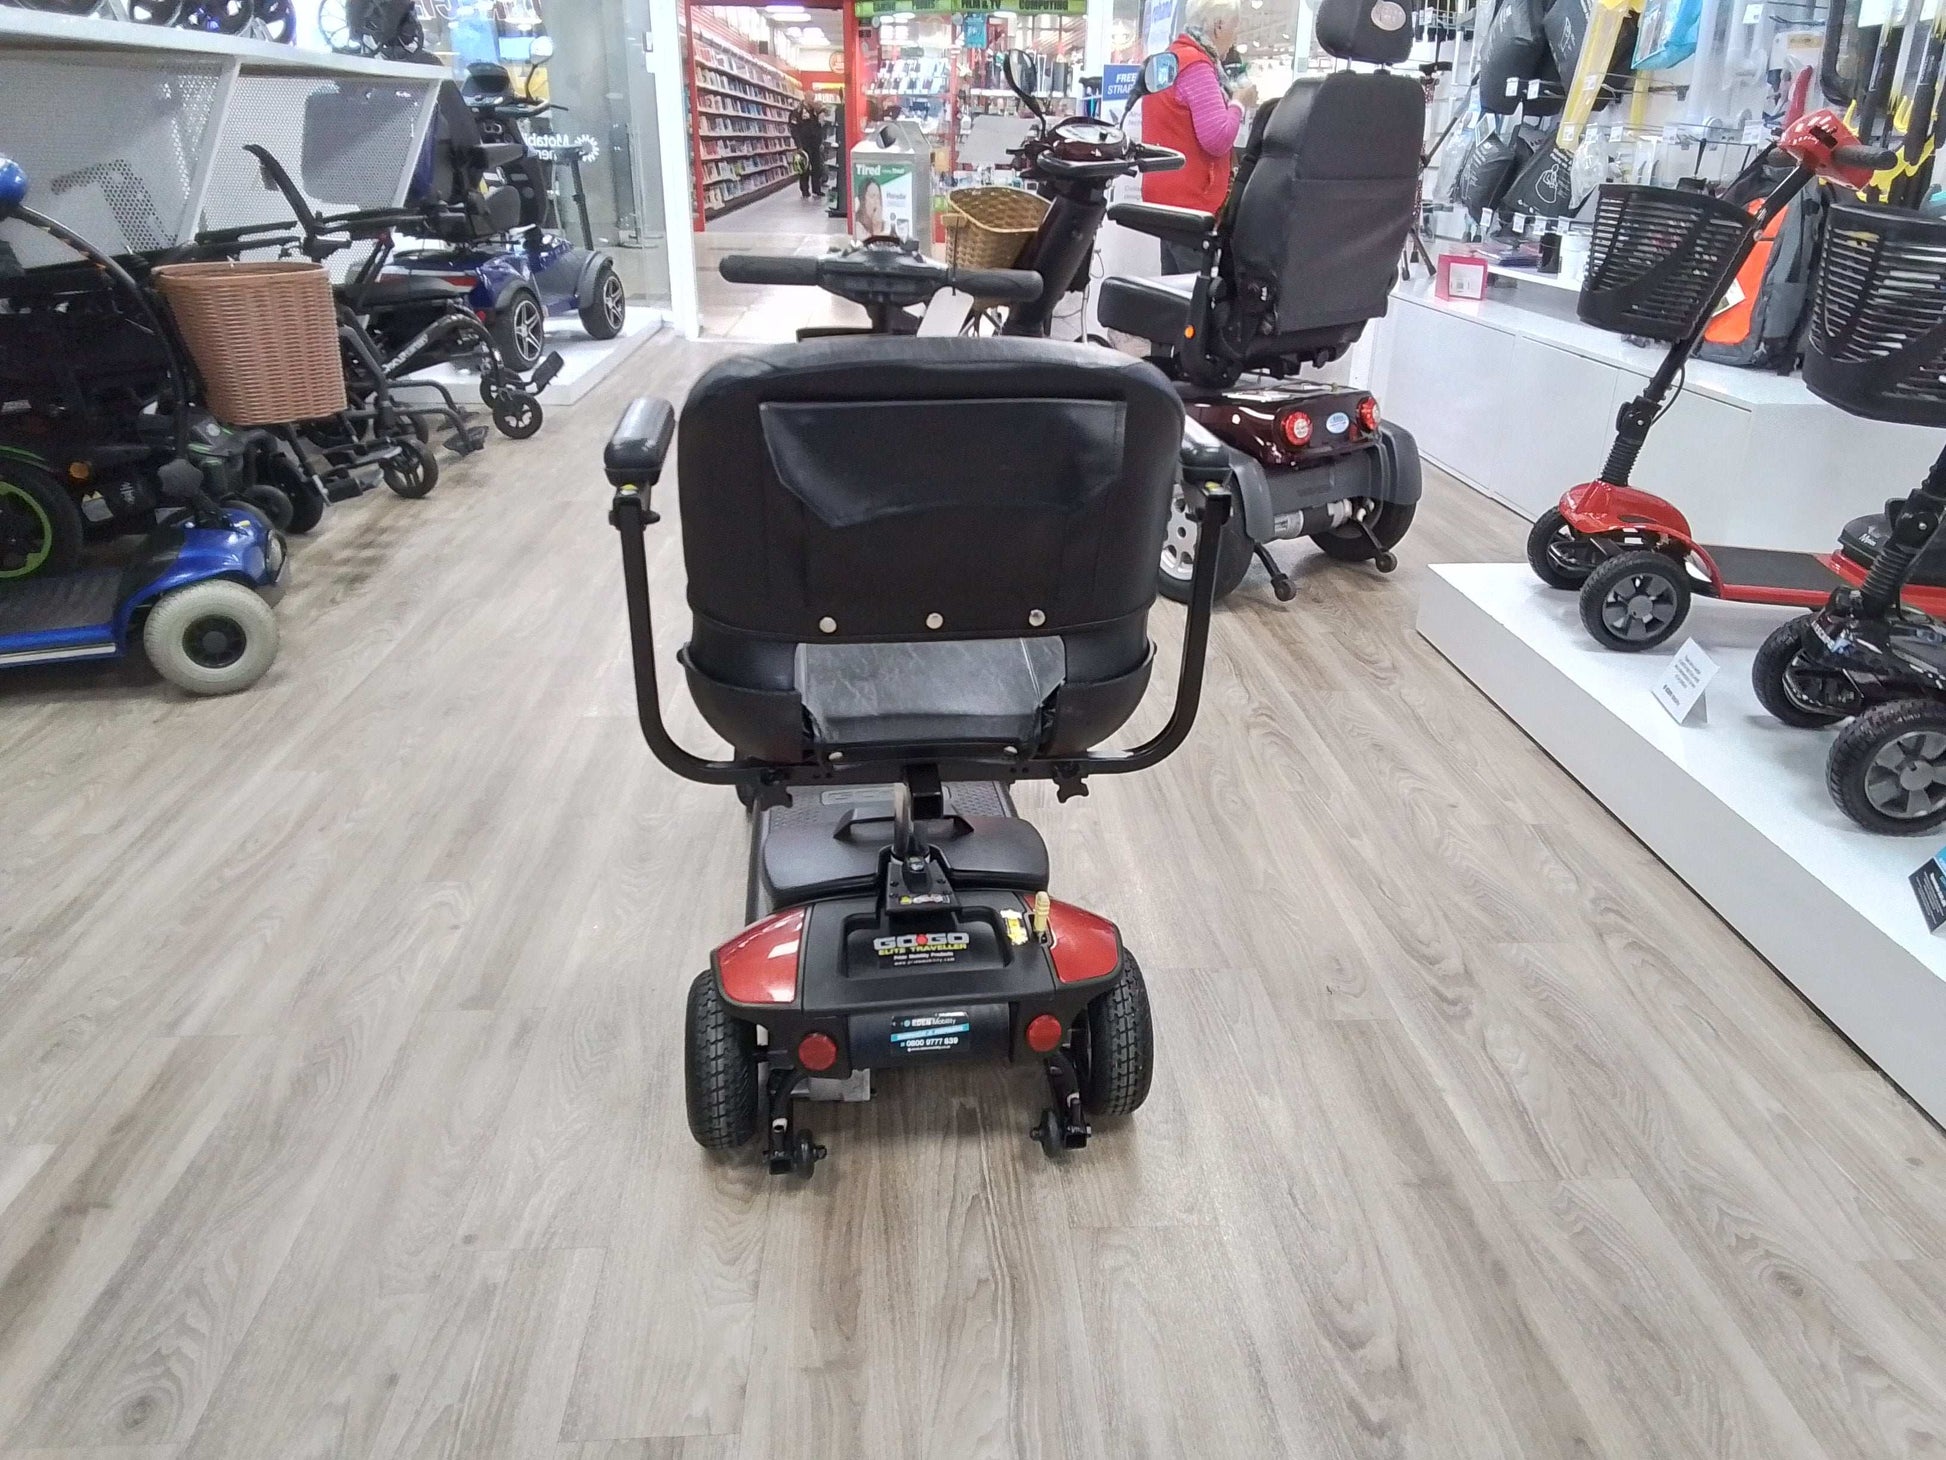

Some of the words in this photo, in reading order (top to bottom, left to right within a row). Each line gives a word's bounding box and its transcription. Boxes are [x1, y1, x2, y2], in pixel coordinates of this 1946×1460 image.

[1116, 73, 1137, 83] FREE
[856, 164, 880, 175] Tired
[909, 944, 967, 952] TRAVELLER
[906, 1039, 924, 1047] 0800
